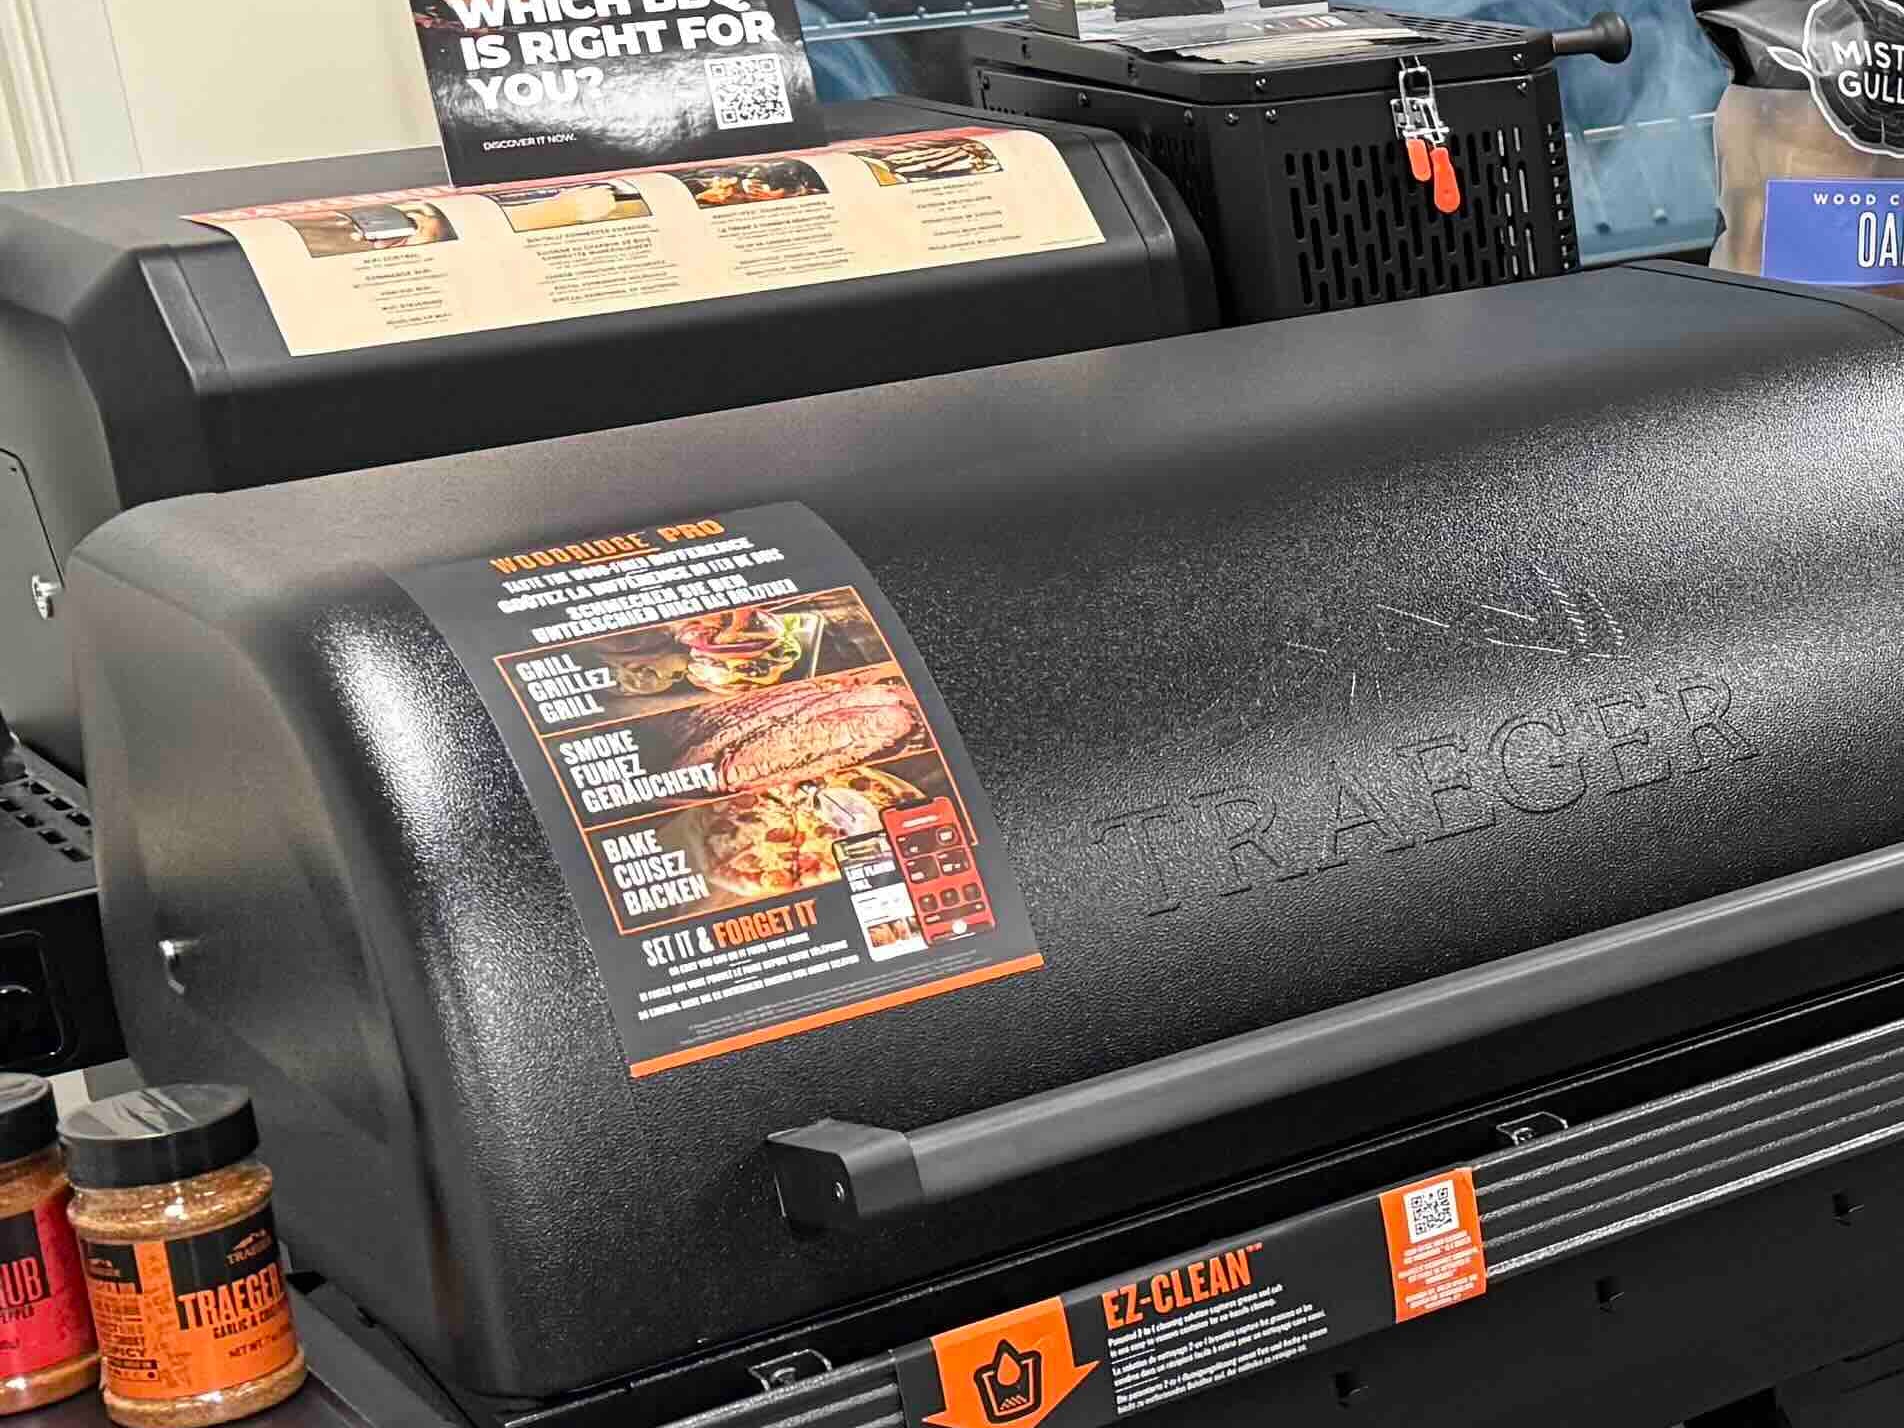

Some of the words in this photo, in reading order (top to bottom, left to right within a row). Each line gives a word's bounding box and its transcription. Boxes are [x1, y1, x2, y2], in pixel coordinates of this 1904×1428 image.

[460, 28, 510, 70] IS
[518, 20, 668, 65] RIGHT
[678, 11, 779, 50] FOR
[467, 70, 605, 111] YOU?
[483, 136, 535, 152] DISCOVER
[536, 135, 546, 146] IT
[1814, 194, 1877, 205] WOOD
[490, 531, 650, 574] WOODRIDGE
[657, 519, 725, 542] PRO
[503, 575, 544, 594] TASTE
[546, 570, 572, 587] THE
[569, 584, 592, 601] LA
[679, 581, 709, 598] SIE
[516, 654, 582, 682] GRILL
[528, 667, 616, 702] GRILLEZ
[538, 694, 604, 724] GRILL
[560, 729, 639, 765] SMOKE
[570, 753, 646, 788] FUMEZ
[1094, 679, 1759, 918] TRAEGER
[602, 829, 663, 863] BAKE
[613, 850, 691, 890] CUISEZ
[623, 873, 711, 916] BACKEN
[641, 936, 675, 967] SET
[675, 930, 695, 959] IT
[696, 926, 715, 953] &
[712, 904, 796, 949] FORGET
[797, 899, 818, 926] IT
[0, 1255, 43, 1309] UB
[212, 1318, 248, 1340] GARLIC
